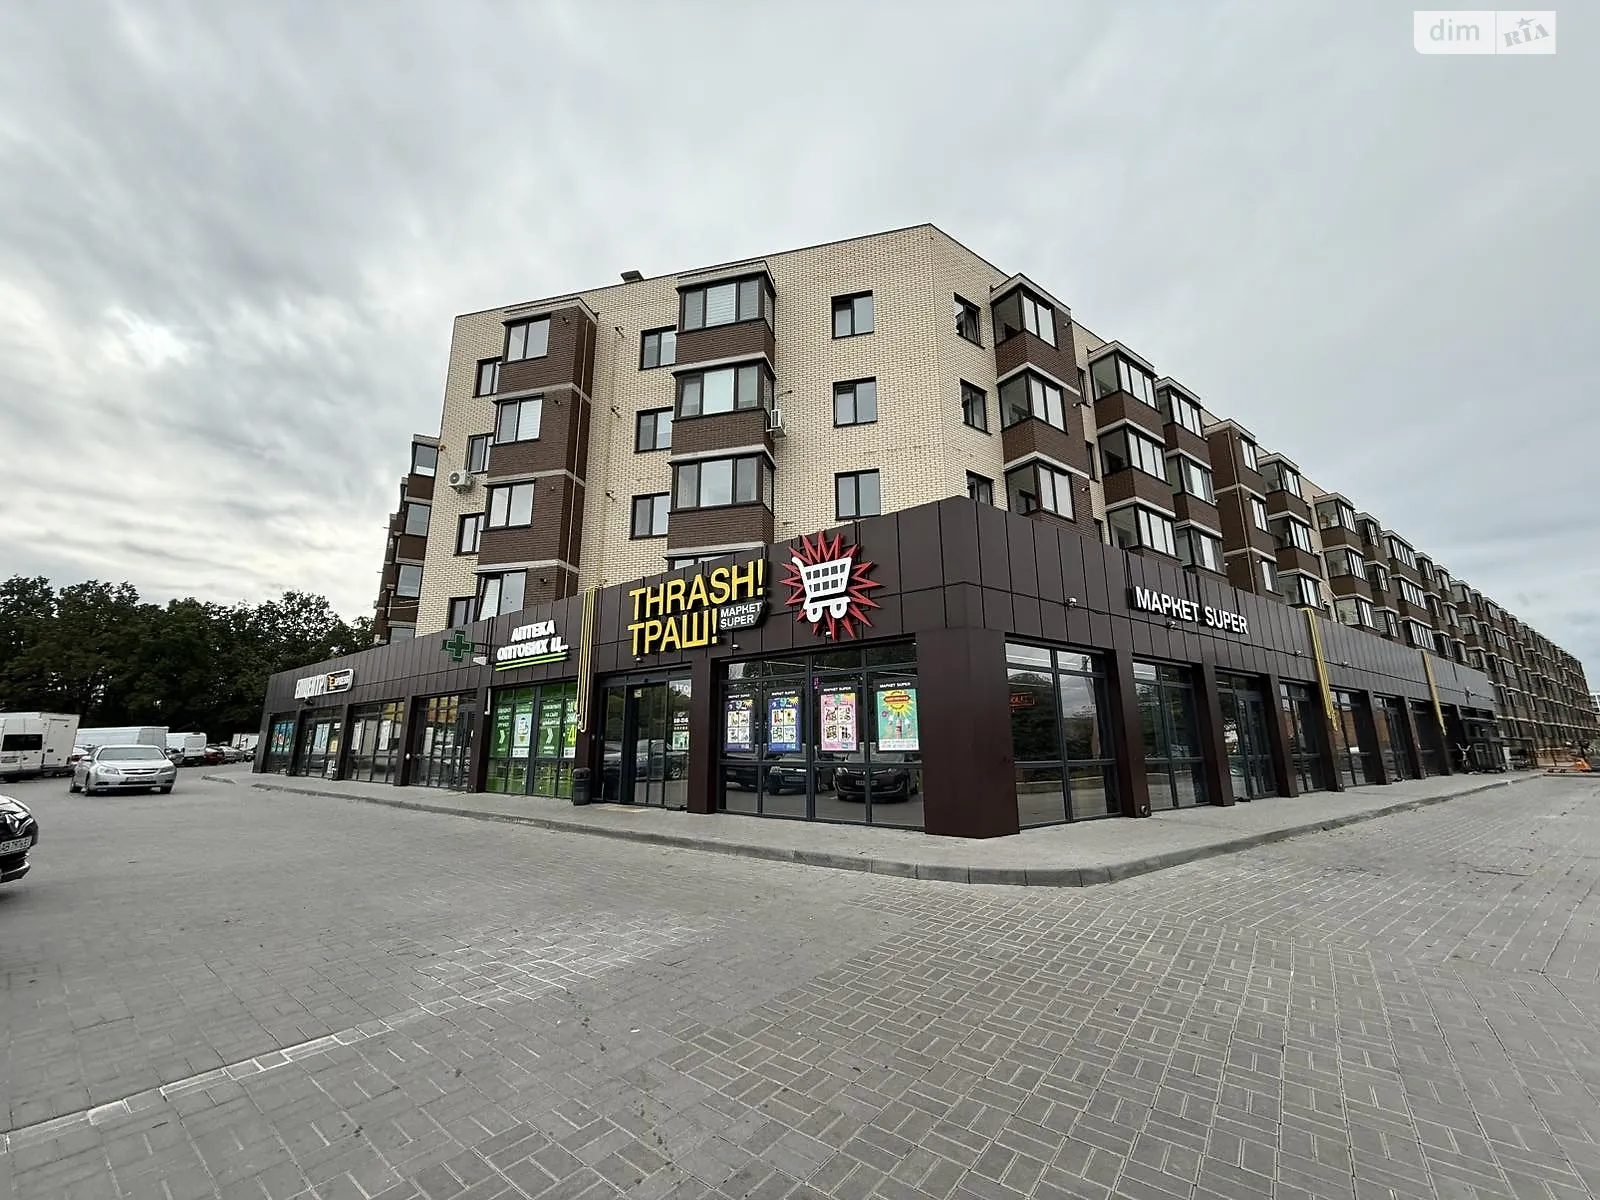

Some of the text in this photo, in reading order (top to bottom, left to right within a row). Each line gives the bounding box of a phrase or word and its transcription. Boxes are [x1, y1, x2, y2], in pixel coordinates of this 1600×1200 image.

[629, 558, 764, 621] THRASH!
[720, 601, 762, 618] МАРКЕТ
[720, 613, 754, 629] SUPER
[1135, 586, 1249, 635] МАРКЕТ SUPER
[511, 619, 556, 643] АПТЕКА
[627, 607, 718, 656] ТРАШ!
